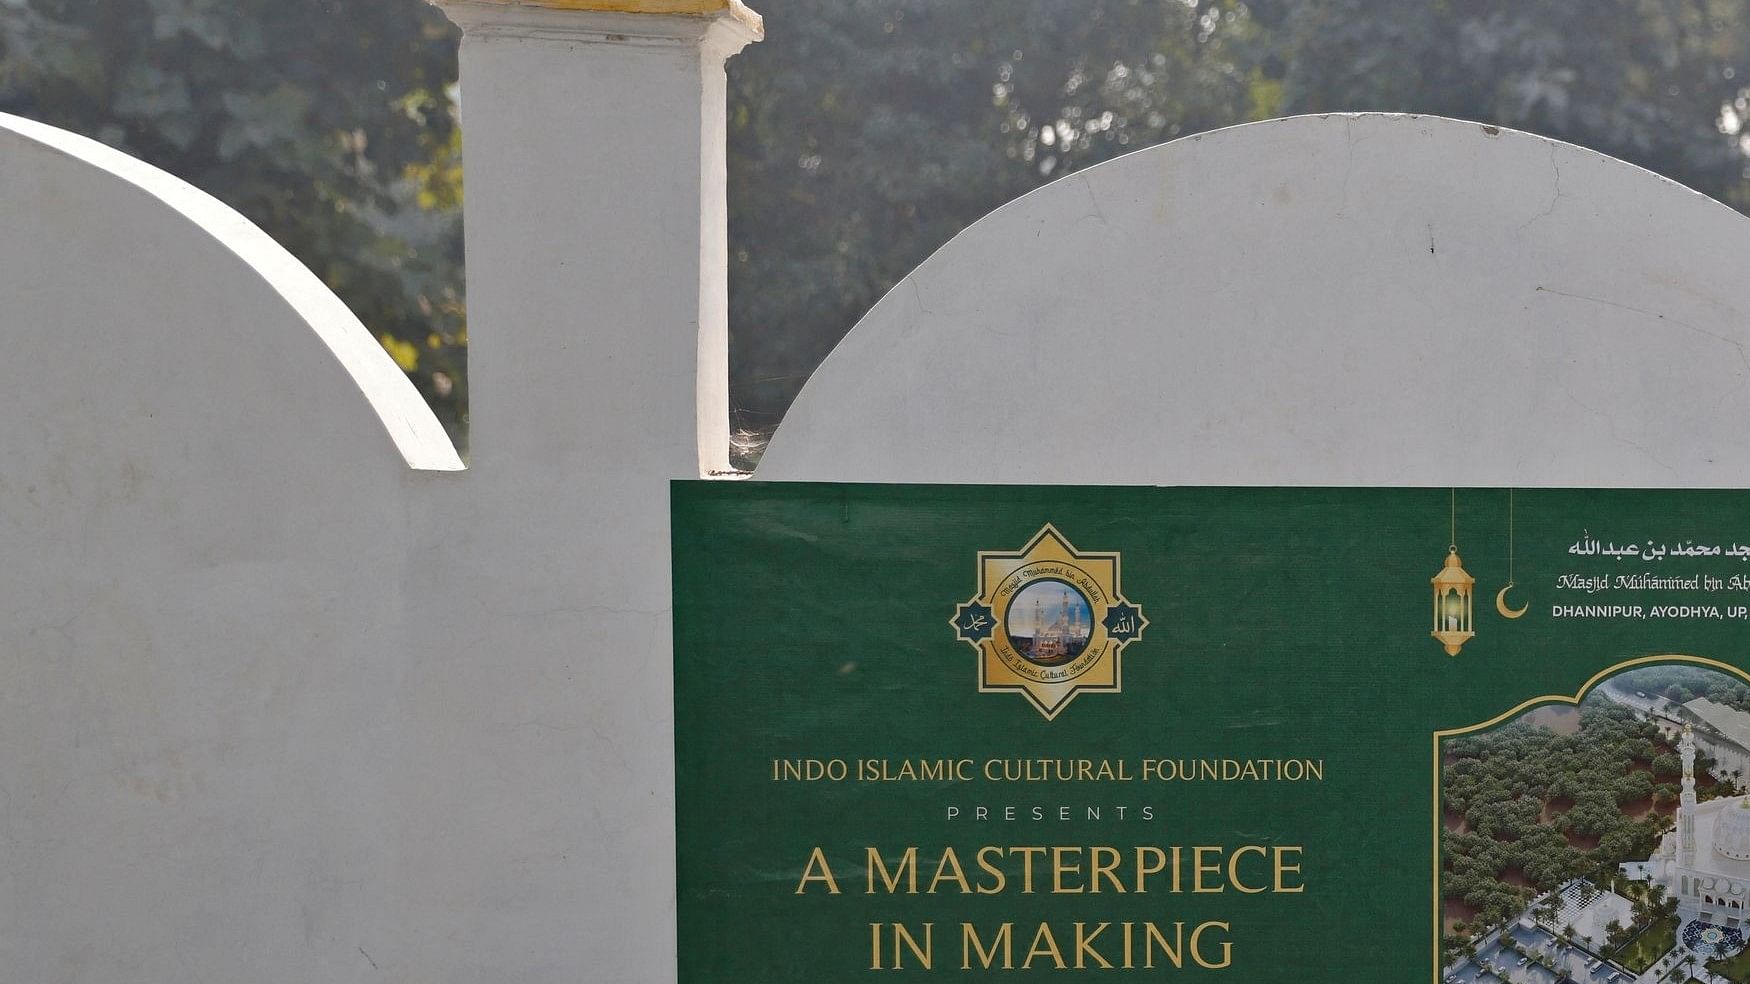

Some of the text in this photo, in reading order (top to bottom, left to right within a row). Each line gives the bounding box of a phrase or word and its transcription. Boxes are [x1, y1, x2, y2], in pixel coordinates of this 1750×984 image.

[1642, 540, 1667, 561] بن
[1556, 573, 1610, 594] Masjid
[1704, 573, 1723, 592] bin
[1552, 605, 1646, 620] DHANNIPUR,
[1650, 605, 1723, 620] AYODHYA,
[1727, 606, 1748, 620] UP,
[772, 758, 1325, 782] INDO ISLAMIC CULTURAL FOUNDATION
[946, 805, 1155, 821] PRESENTS
[794, 845, 1305, 895] A MASTERPIECE
[869, 920, 1234, 970] IN MAKING
